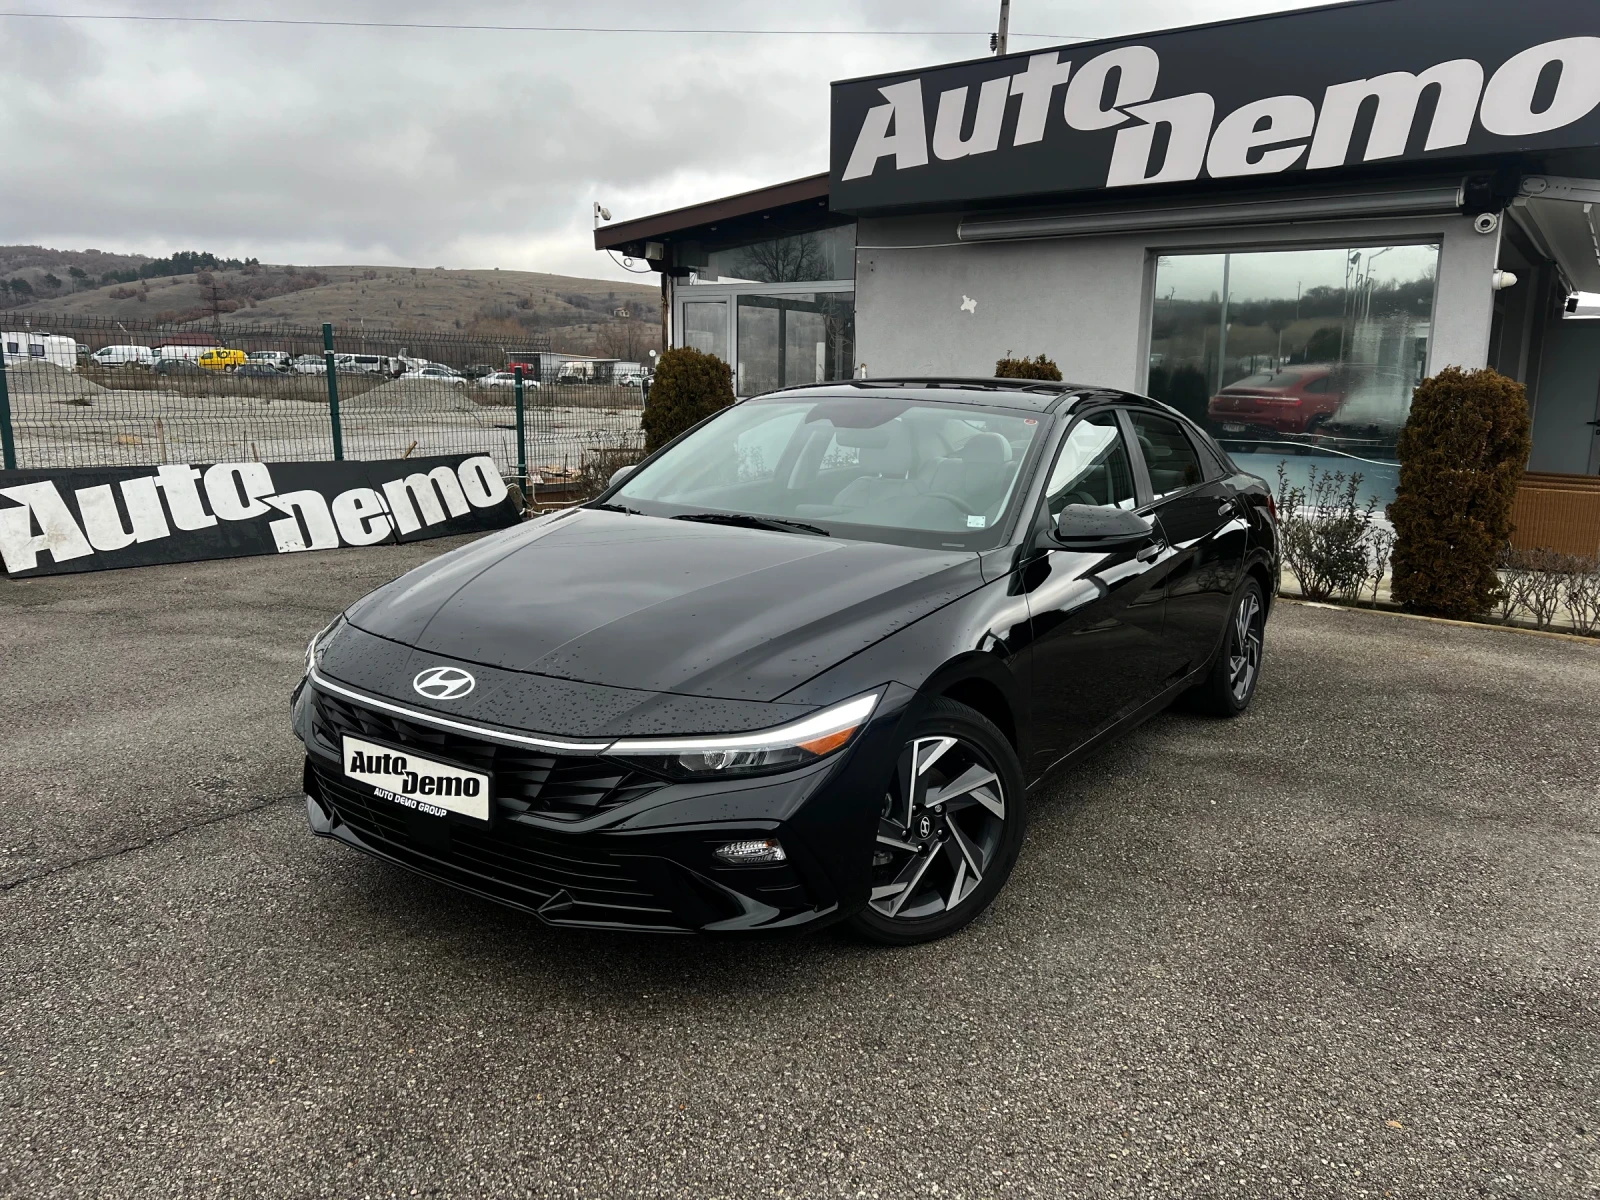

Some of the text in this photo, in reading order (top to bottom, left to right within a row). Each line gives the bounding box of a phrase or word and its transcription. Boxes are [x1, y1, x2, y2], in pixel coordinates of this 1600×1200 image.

[841, 36, 1600, 188] Auto Demo
[0, 456, 508, 573] Auto Demo
[350, 751, 480, 797] Auto Demo
[373, 787, 447, 817] AUTO DEMO GROUP
